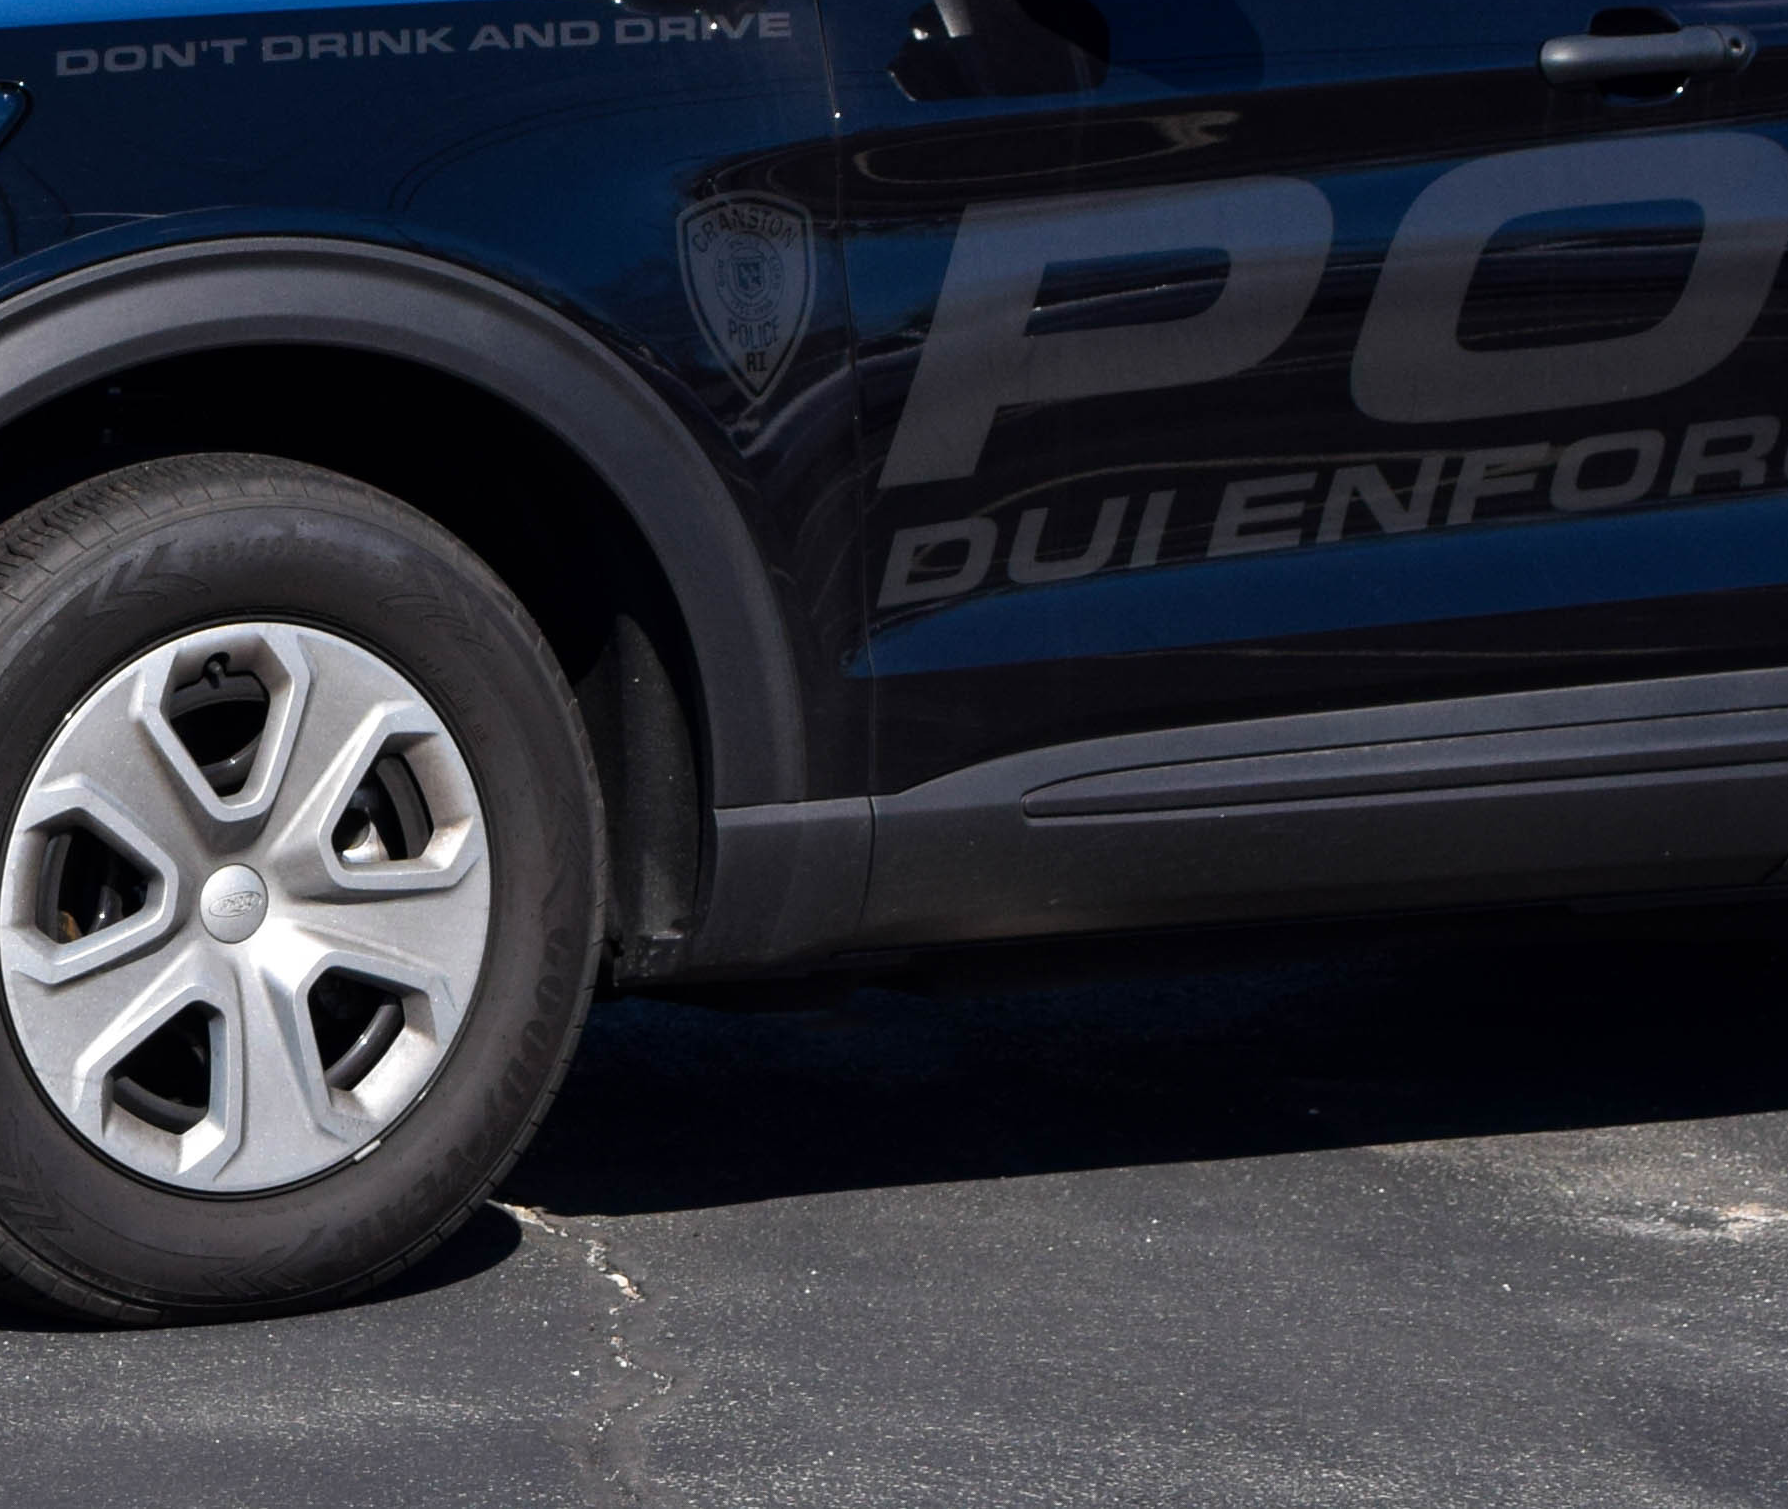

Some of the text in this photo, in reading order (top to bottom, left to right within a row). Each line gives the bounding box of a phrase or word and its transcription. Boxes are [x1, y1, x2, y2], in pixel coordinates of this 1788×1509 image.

[55, 10, 792, 78] DON'T DRINK AND DRIVE
[692, 207, 799, 254] CRANSTON
[727, 314, 780, 351] POLICE
[876, 491, 1178, 609] DUI
